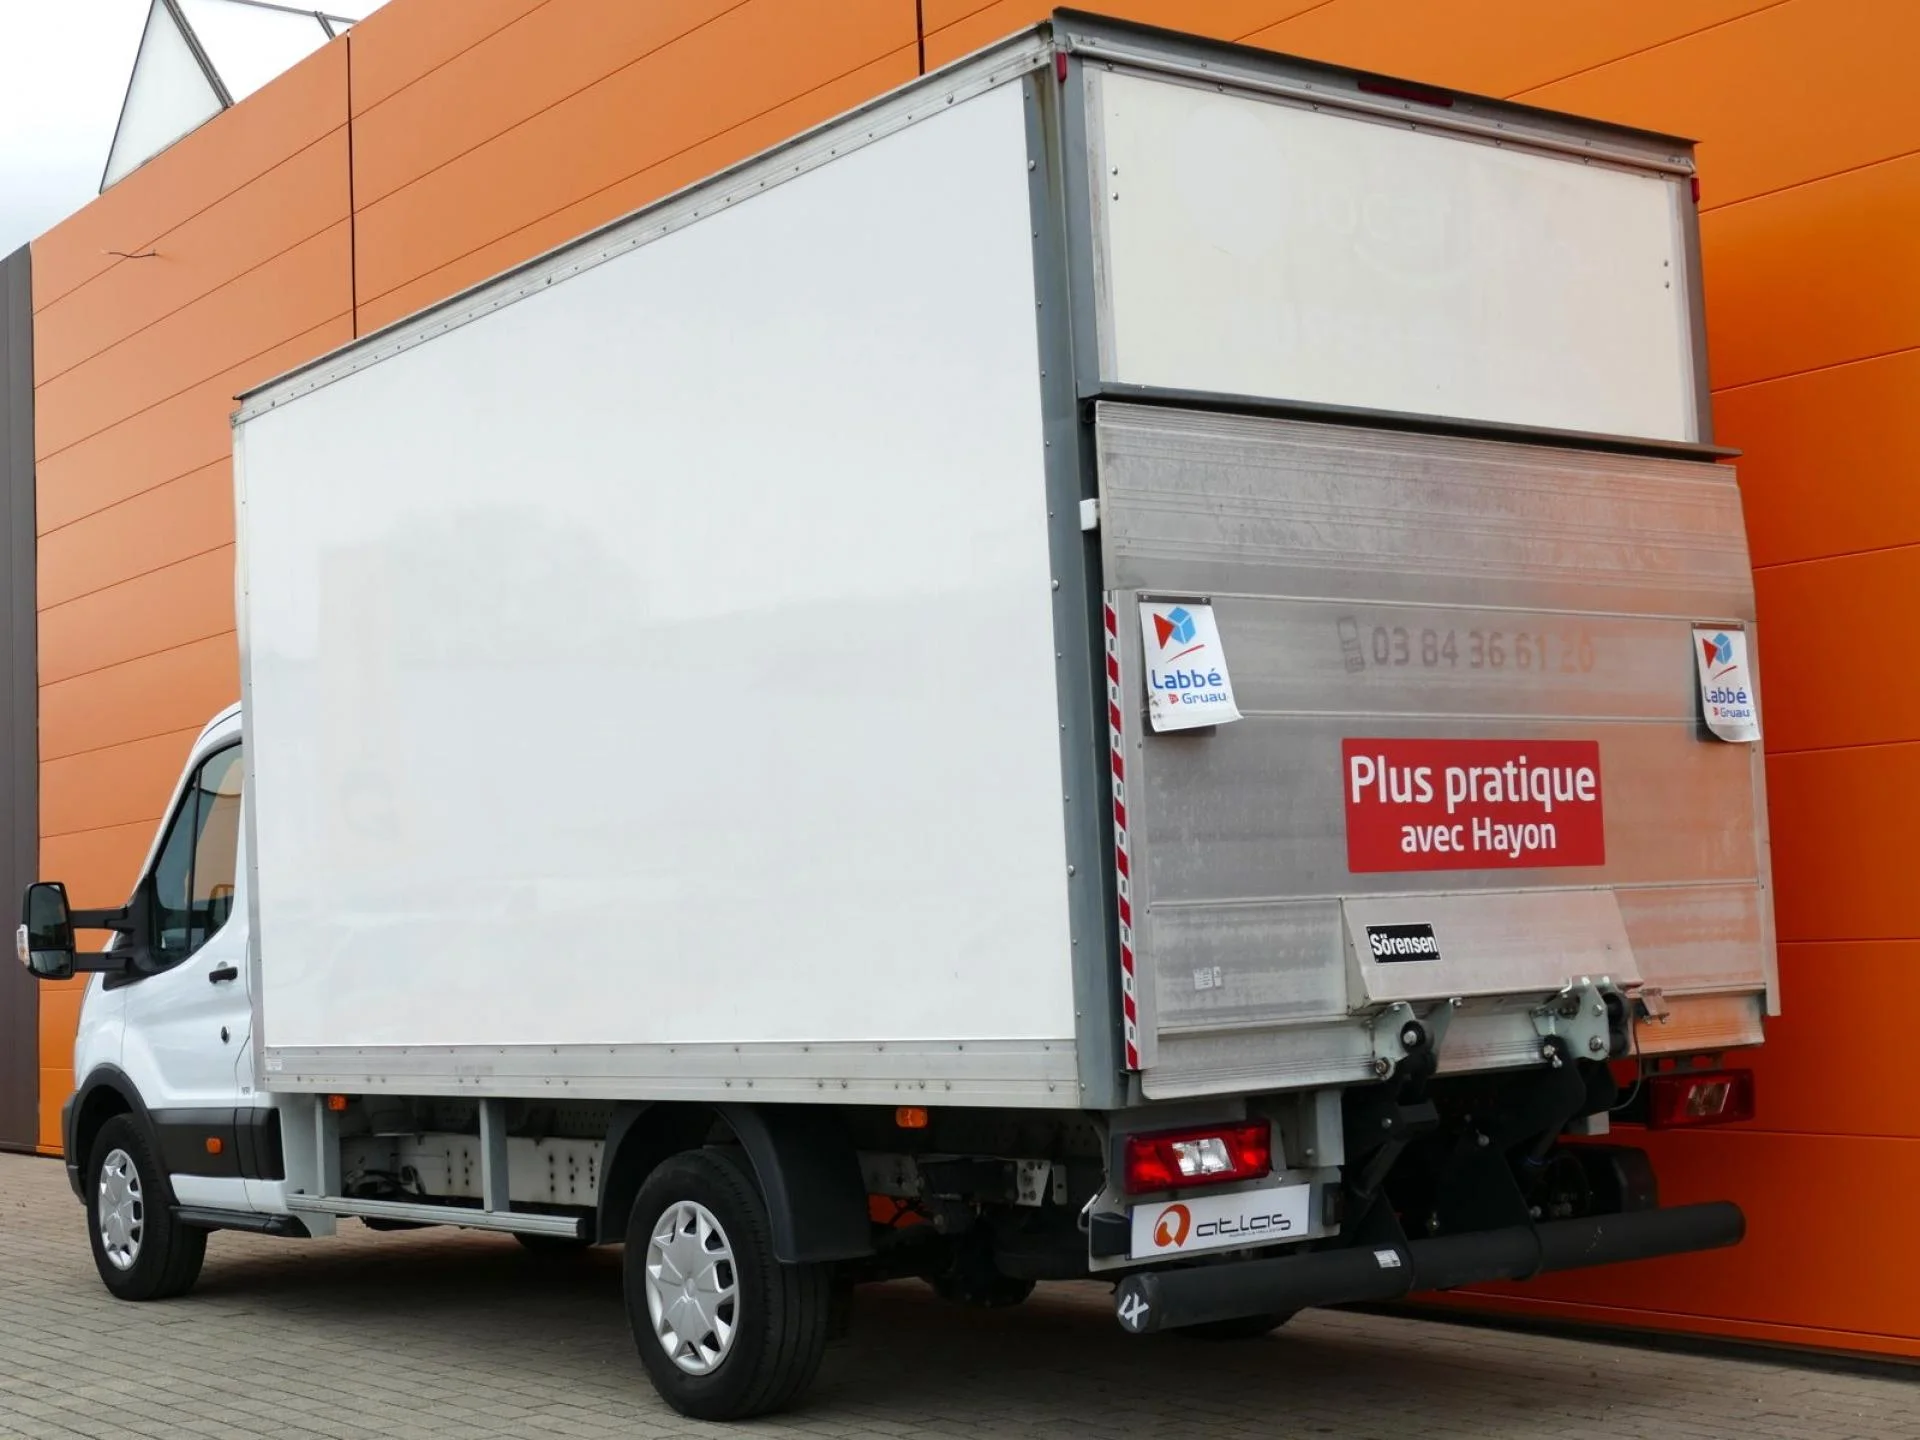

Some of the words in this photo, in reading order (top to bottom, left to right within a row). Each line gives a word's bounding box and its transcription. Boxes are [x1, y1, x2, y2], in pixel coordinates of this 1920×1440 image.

[1371, 626, 1410, 666] 03
[1421, 628, 1459, 667] 84
[1469, 630, 1505, 669] 36
[1515, 632, 1547, 671] 61
[1151, 667, 1223, 689] Labbé
[1182, 692, 1227, 704] Gruau
[1704, 686, 1747, 704] Labbé
[1720, 707, 1750, 718] Gruau
[1350, 755, 1434, 803] Plus
[1445, 755, 1596, 814] pratique
[1401, 824, 1465, 853] avec
[1472, 817, 1556, 858] Hayon
[1370, 933, 1438, 956] Sörensen
[1196, 1213, 1291, 1237] atlas
[1118, 1291, 1150, 1329] 4
